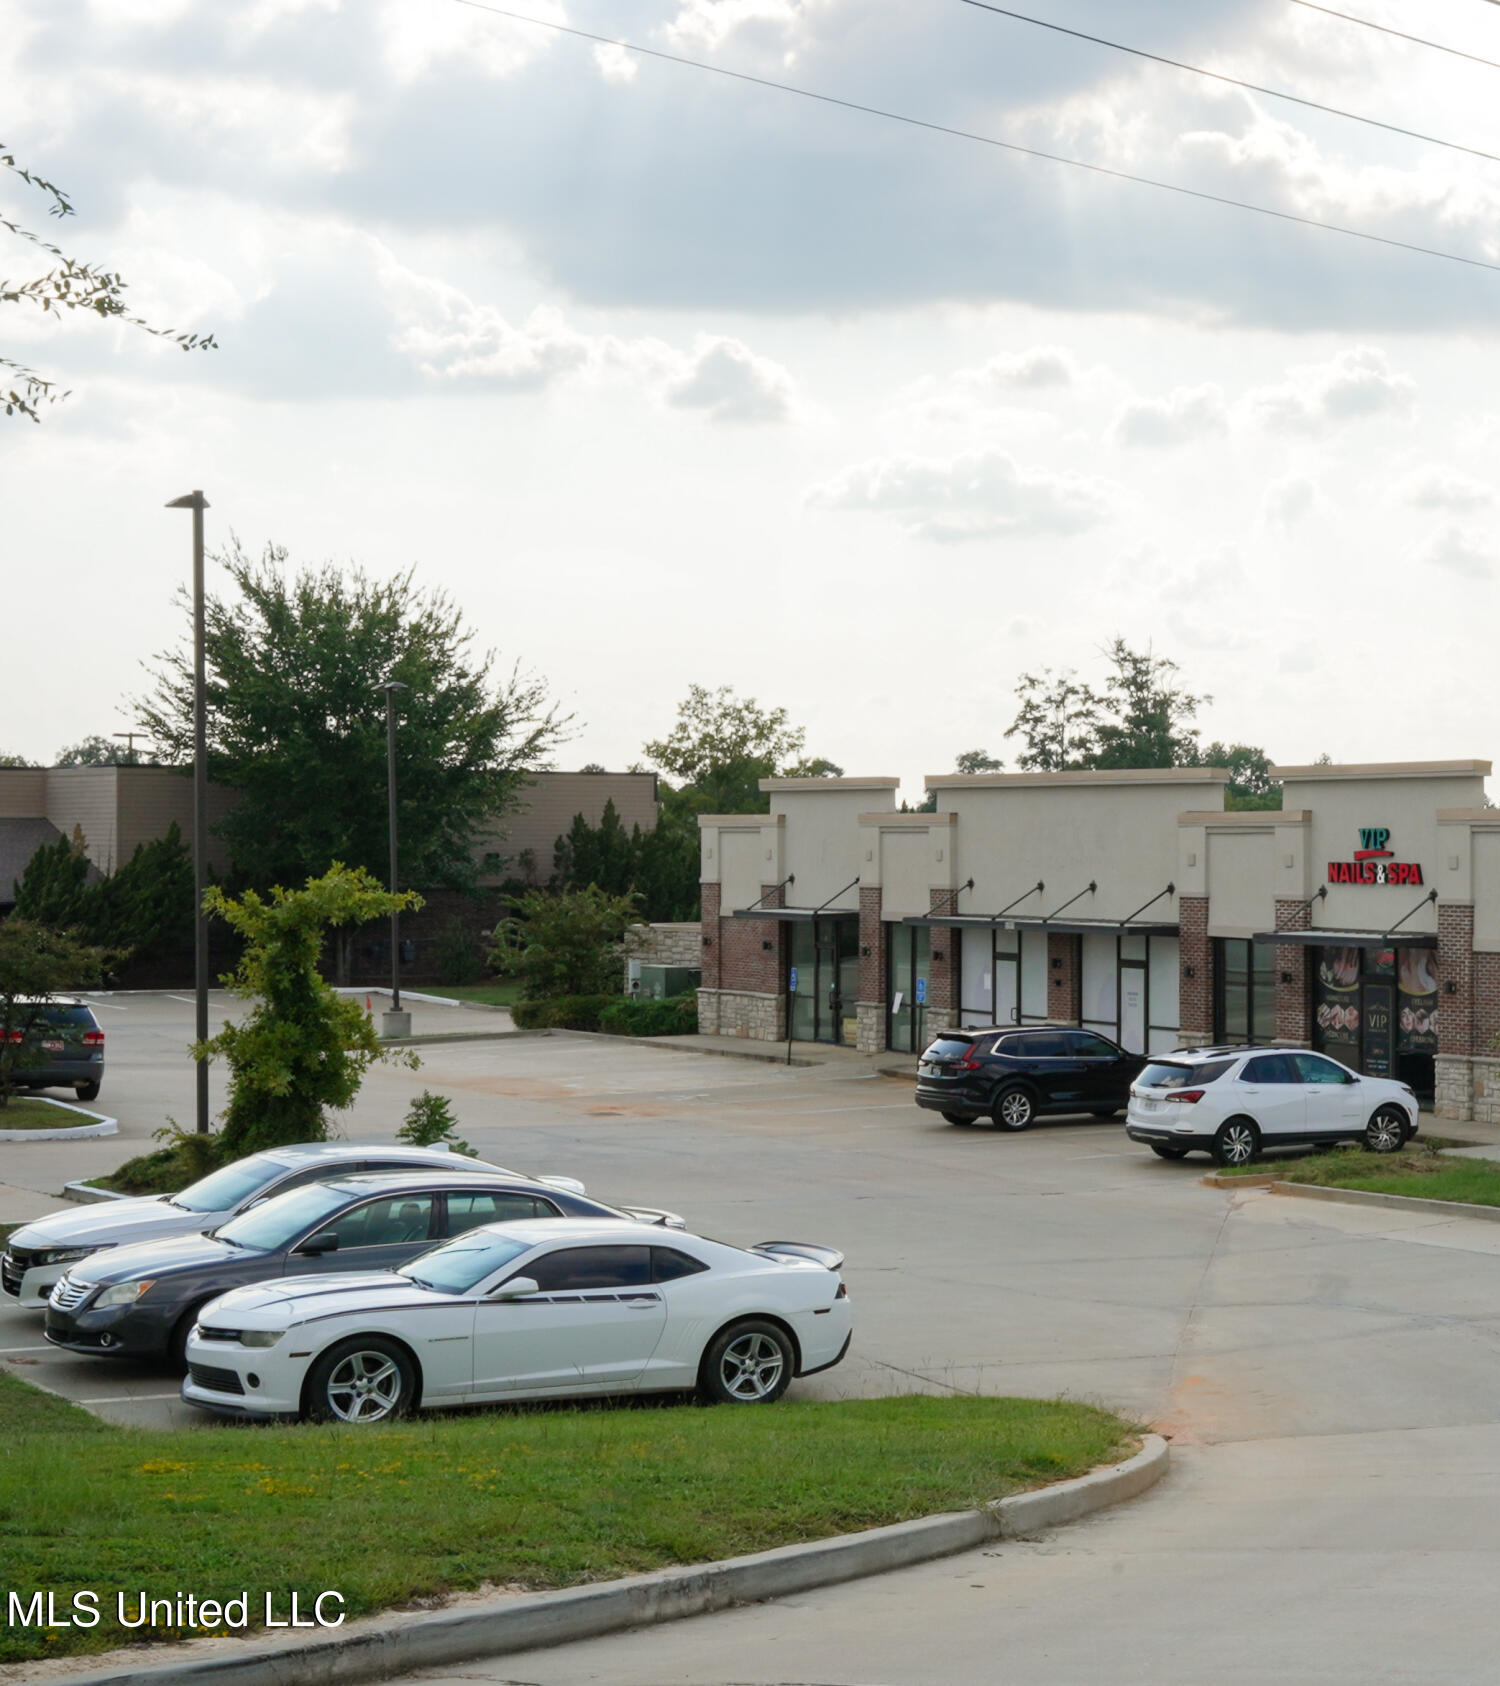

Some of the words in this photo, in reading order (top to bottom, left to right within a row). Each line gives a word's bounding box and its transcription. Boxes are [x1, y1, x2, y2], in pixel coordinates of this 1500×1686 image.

[1358, 828, 1390, 849] VIP
[1328, 862, 1377, 884] NAILS
[1377, 864, 1386, 884] &
[1387, 862, 1424, 885] SPA
[1368, 1014, 1388, 1028] VIP
